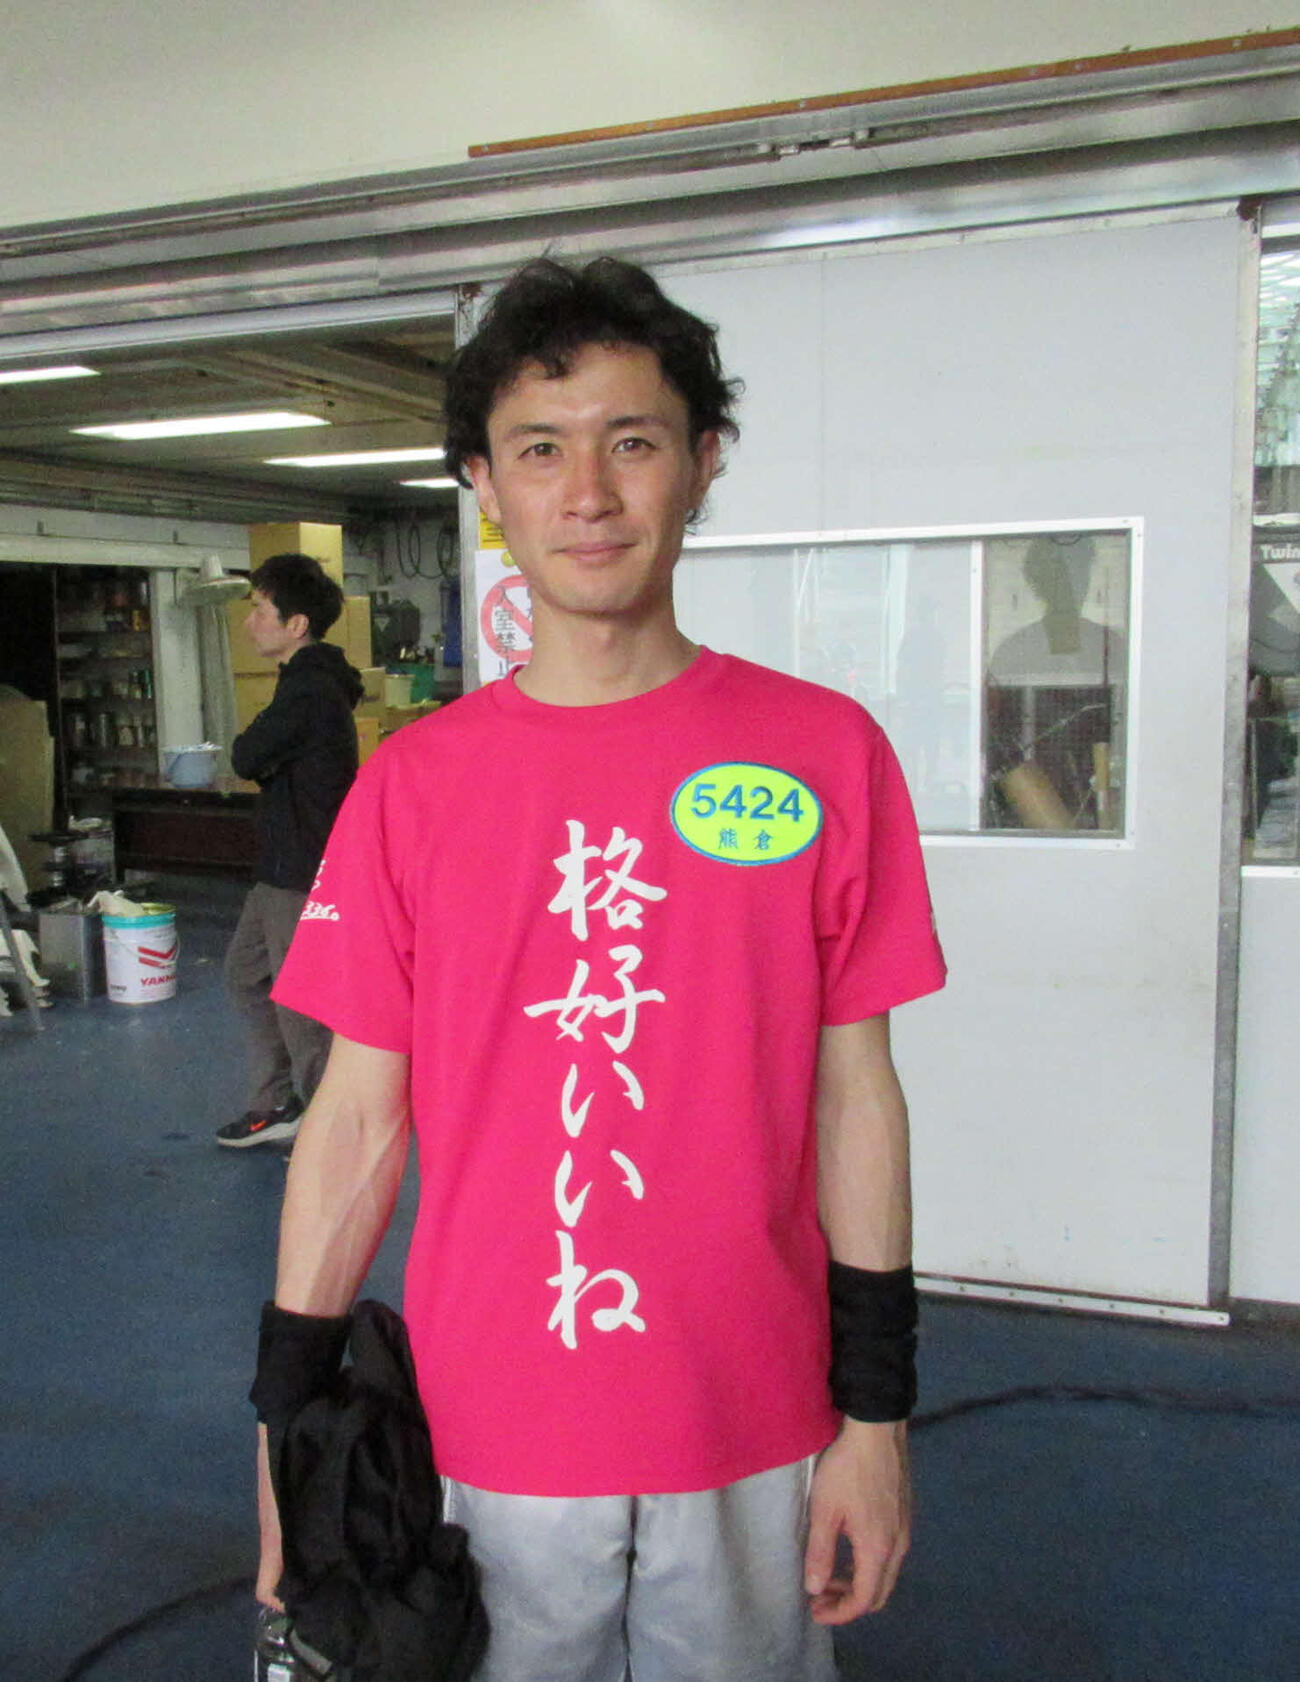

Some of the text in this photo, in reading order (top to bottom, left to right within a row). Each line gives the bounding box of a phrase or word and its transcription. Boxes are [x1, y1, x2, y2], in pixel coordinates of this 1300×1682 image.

[690, 783, 804, 822] 5424
[523, 819, 668, 1350] 格好いいね
